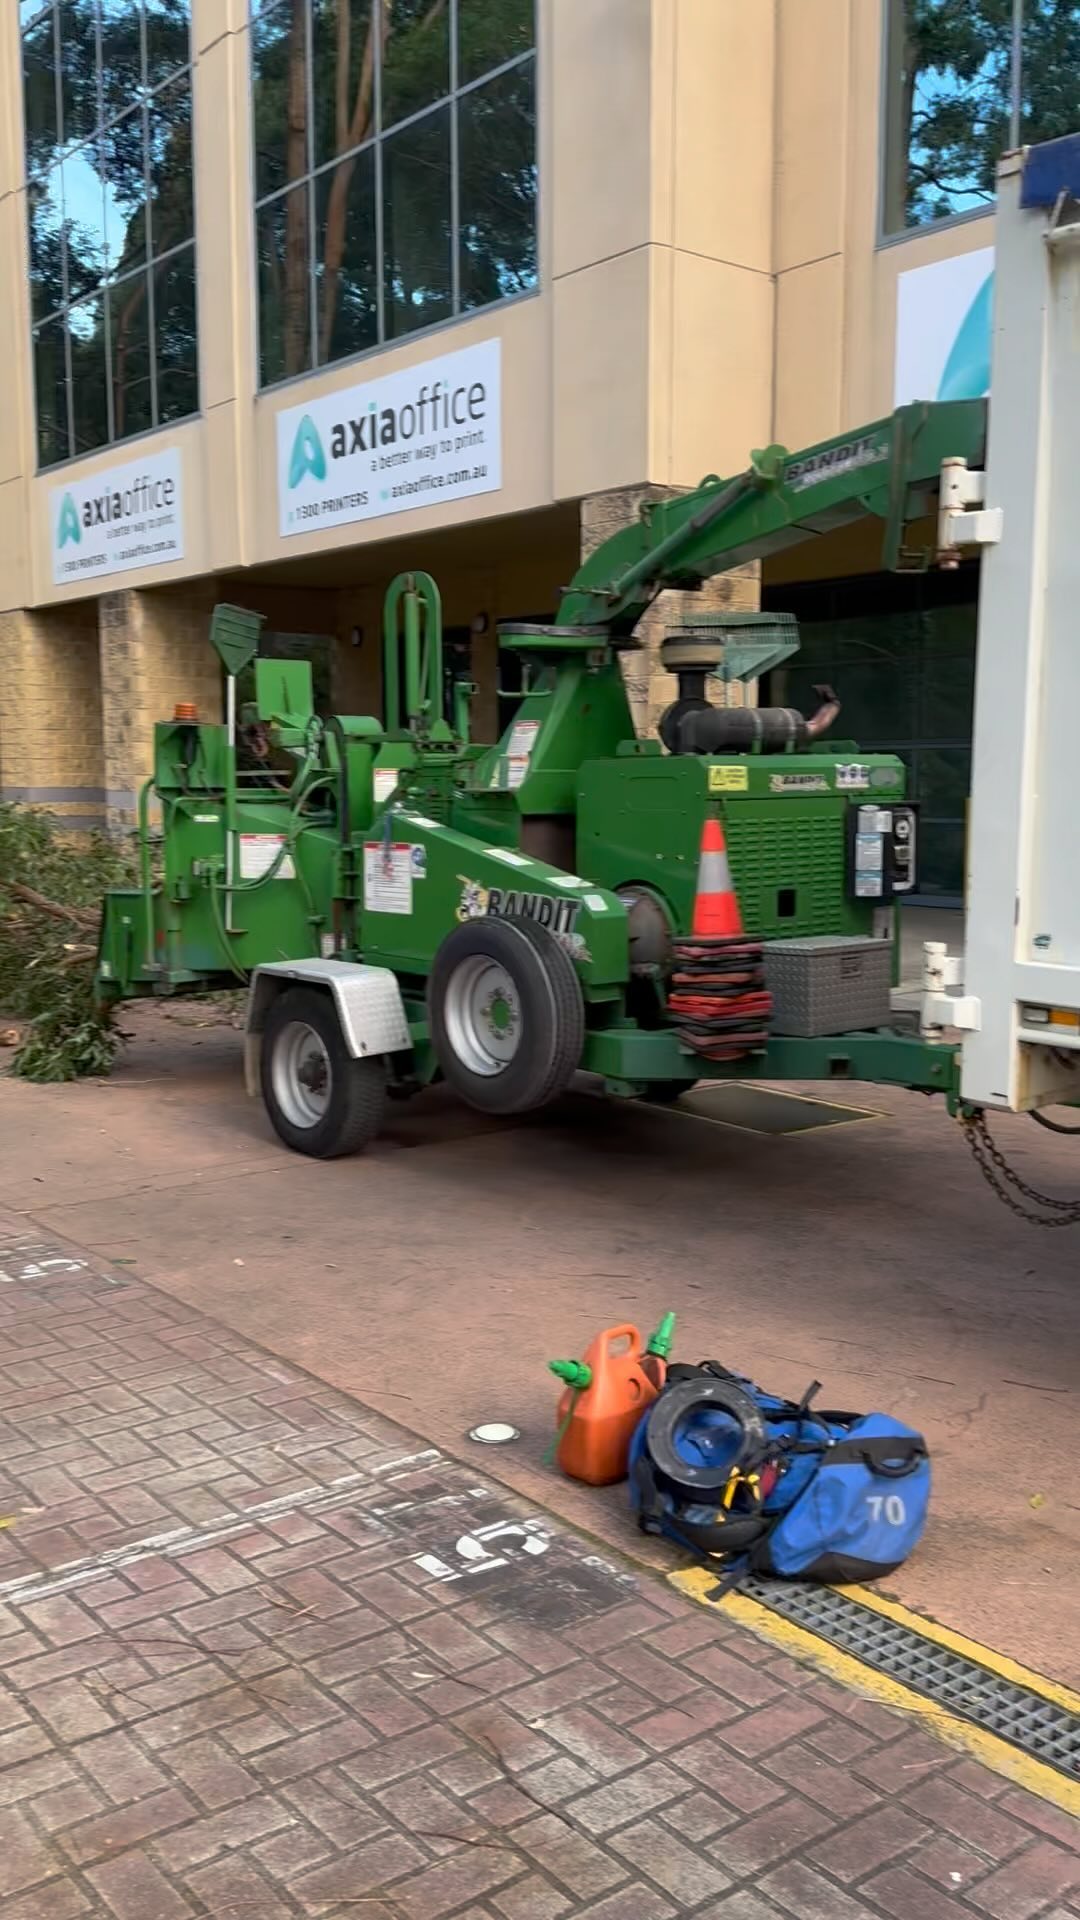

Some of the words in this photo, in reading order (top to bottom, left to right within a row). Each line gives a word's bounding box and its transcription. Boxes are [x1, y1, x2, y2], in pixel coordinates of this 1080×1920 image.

[331, 381, 486, 459] axiaoffice
[379, 450, 412, 469] better
[415, 443, 438, 460] way
[785, 435, 877, 482] BANDIT
[82, 475, 176, 528] axiaoffice
[322, 491, 369, 514] PRINTERS
[391, 464, 488, 498] axiaoffice.com.au
[487, 887, 582, 934] BANDIT
[865, 1494, 907, 1526] 70
